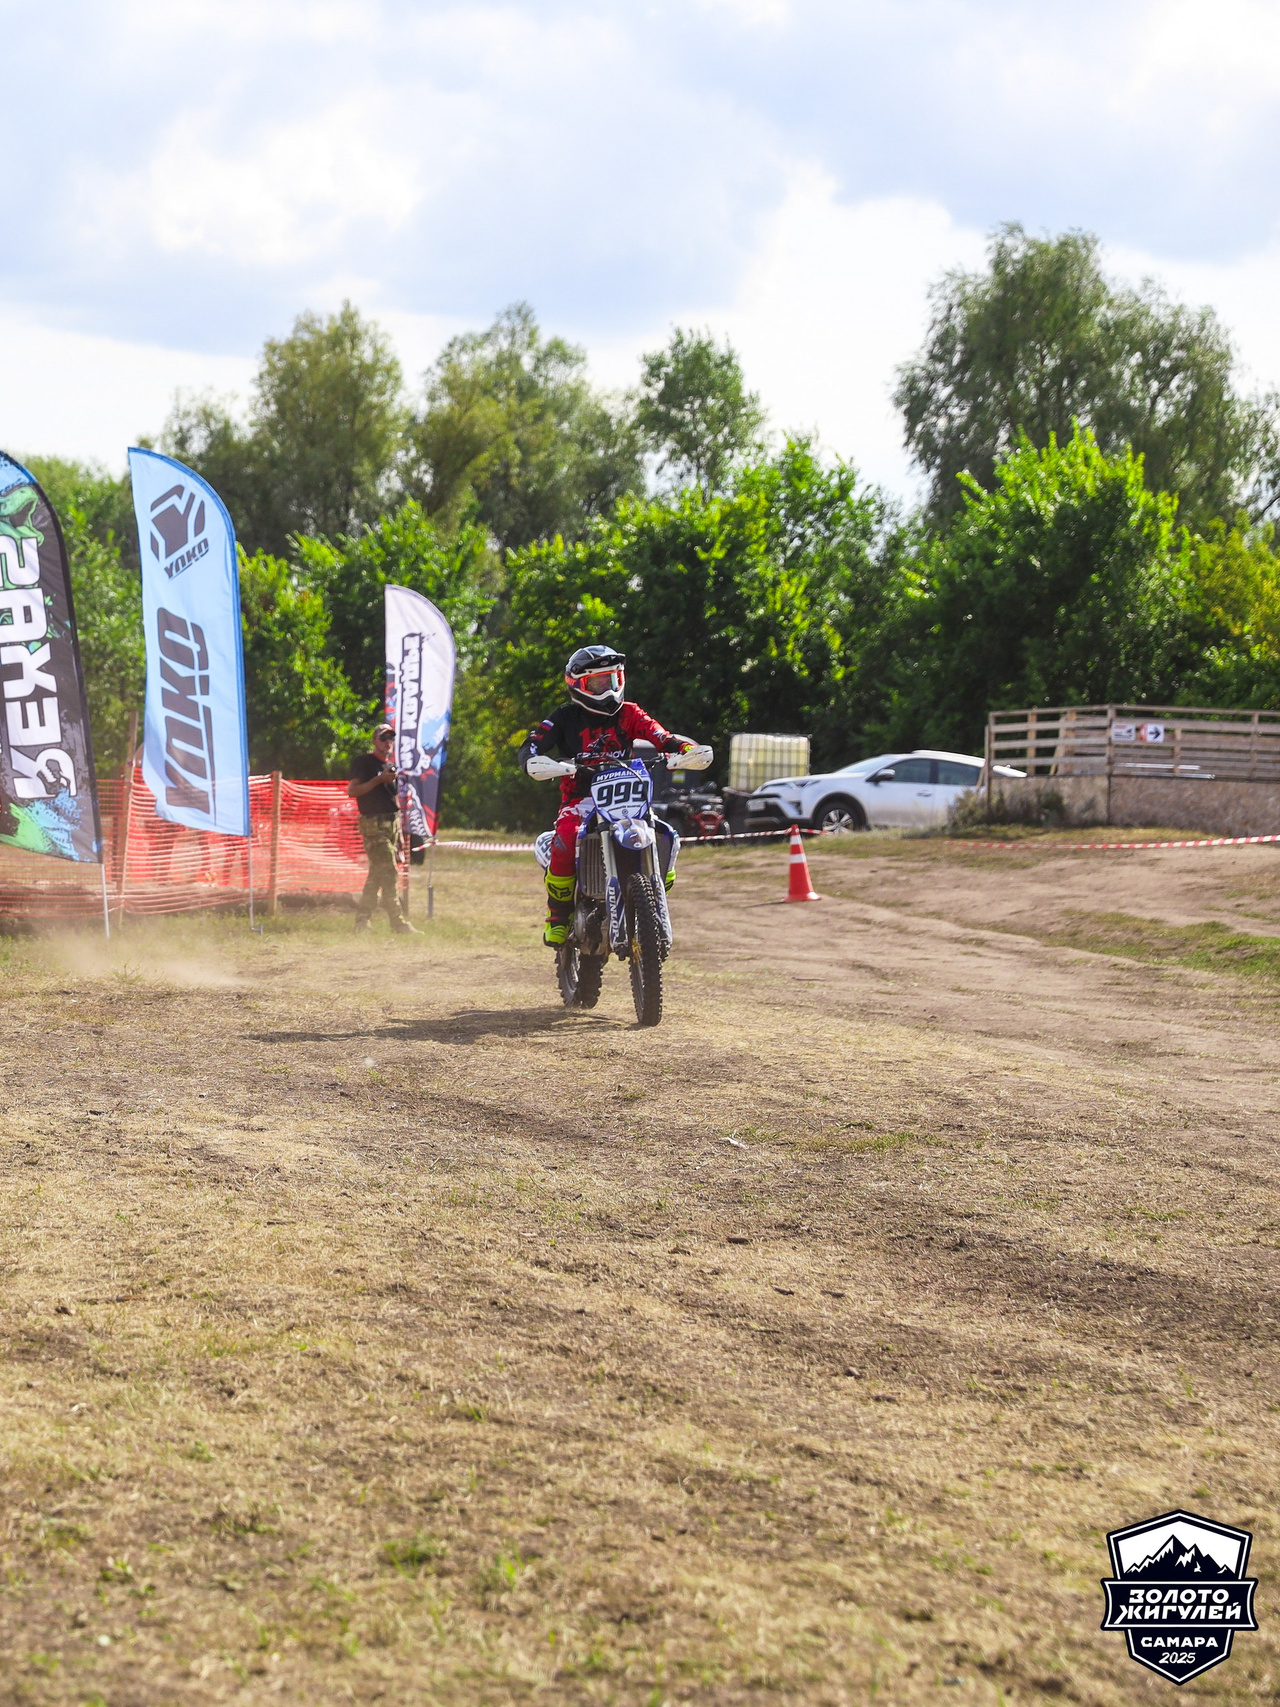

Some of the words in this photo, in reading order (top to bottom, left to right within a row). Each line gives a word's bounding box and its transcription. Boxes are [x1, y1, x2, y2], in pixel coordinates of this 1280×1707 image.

[164, 538, 209, 579] YOKO
[157, 607, 216, 820] YOKO
[597, 781, 649, 808] 999
[608, 886, 620, 941] DUNLOP
